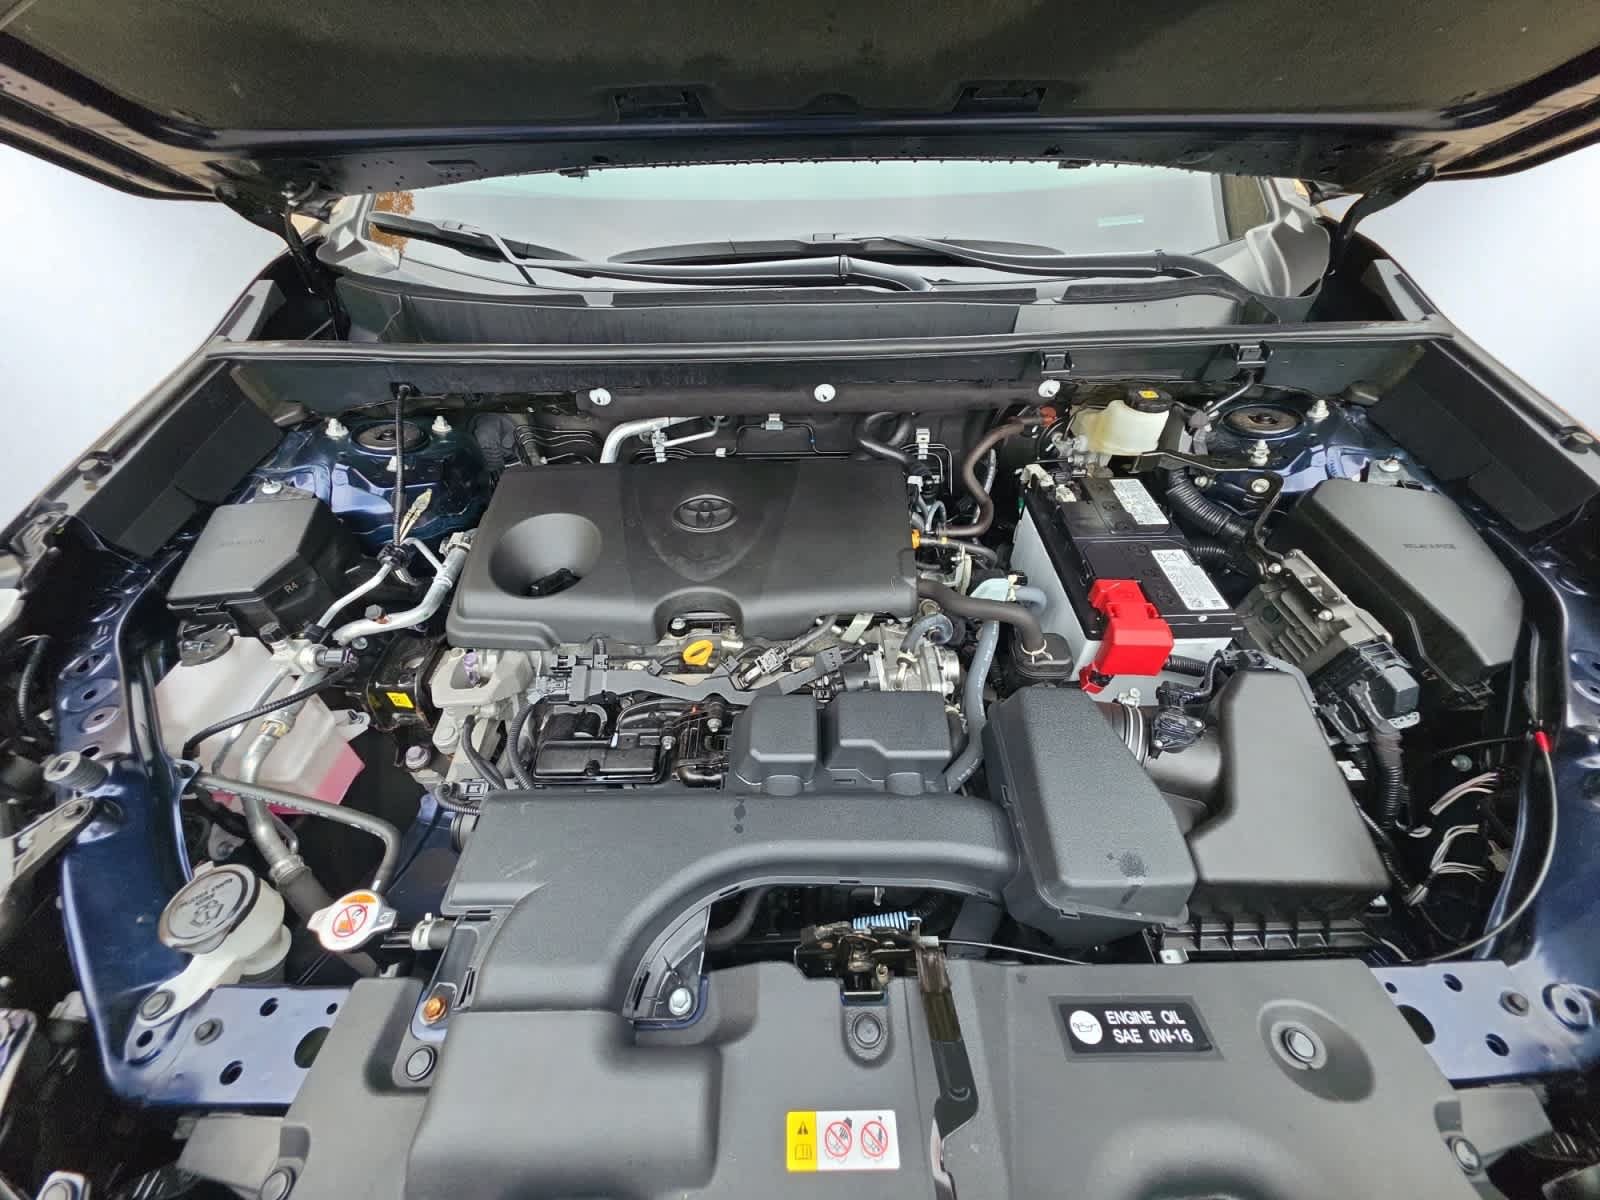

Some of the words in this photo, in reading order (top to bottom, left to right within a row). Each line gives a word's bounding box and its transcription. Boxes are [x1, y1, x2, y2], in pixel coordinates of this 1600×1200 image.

[1104, 1010, 1157, 1025] ENGINE
[1160, 1010, 1186, 1025] OIL
[1112, 1028, 1144, 1044] SAE
[1149, 1028, 1194, 1044] 0W-16
